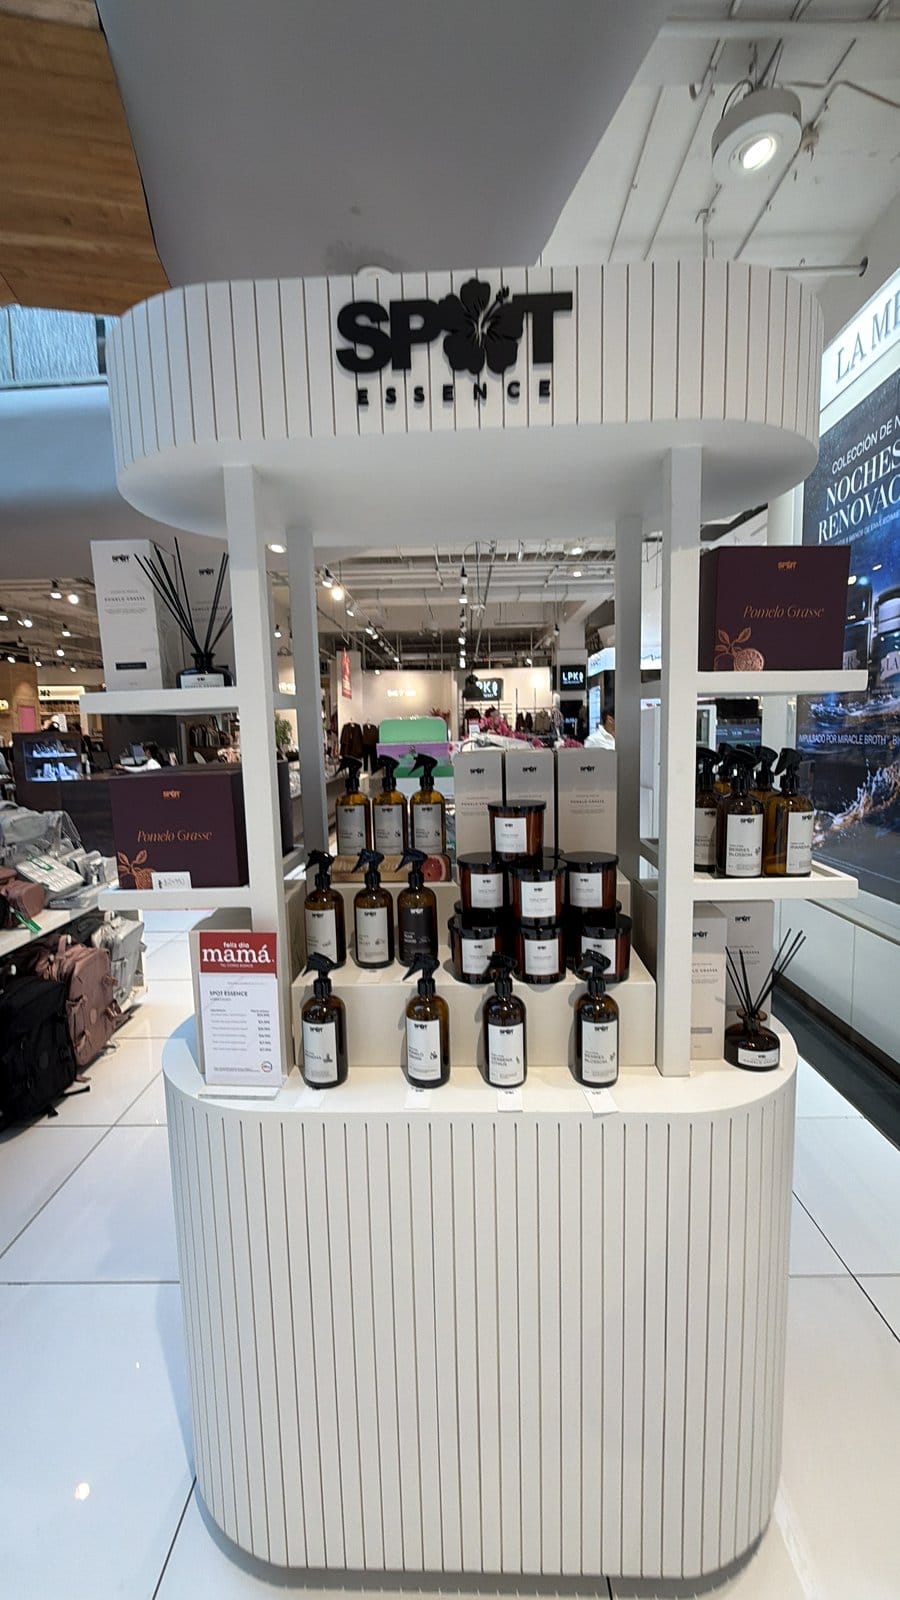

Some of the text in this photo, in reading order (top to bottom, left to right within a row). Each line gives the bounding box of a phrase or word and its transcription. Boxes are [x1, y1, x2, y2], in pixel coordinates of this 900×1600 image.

[836, 331, 867, 384] LA
[356, 379, 551, 406] ESSENCE
[831, 430, 878, 475] COLECCIÓN
[880, 418, 892, 440] DE
[825, 438, 900, 512] NOCHES
[743, 605, 824, 619] Pomelo Grasse
[838, 734, 864, 745] MIRACLE
[137, 829, 213, 843] Pomelo Grasse
